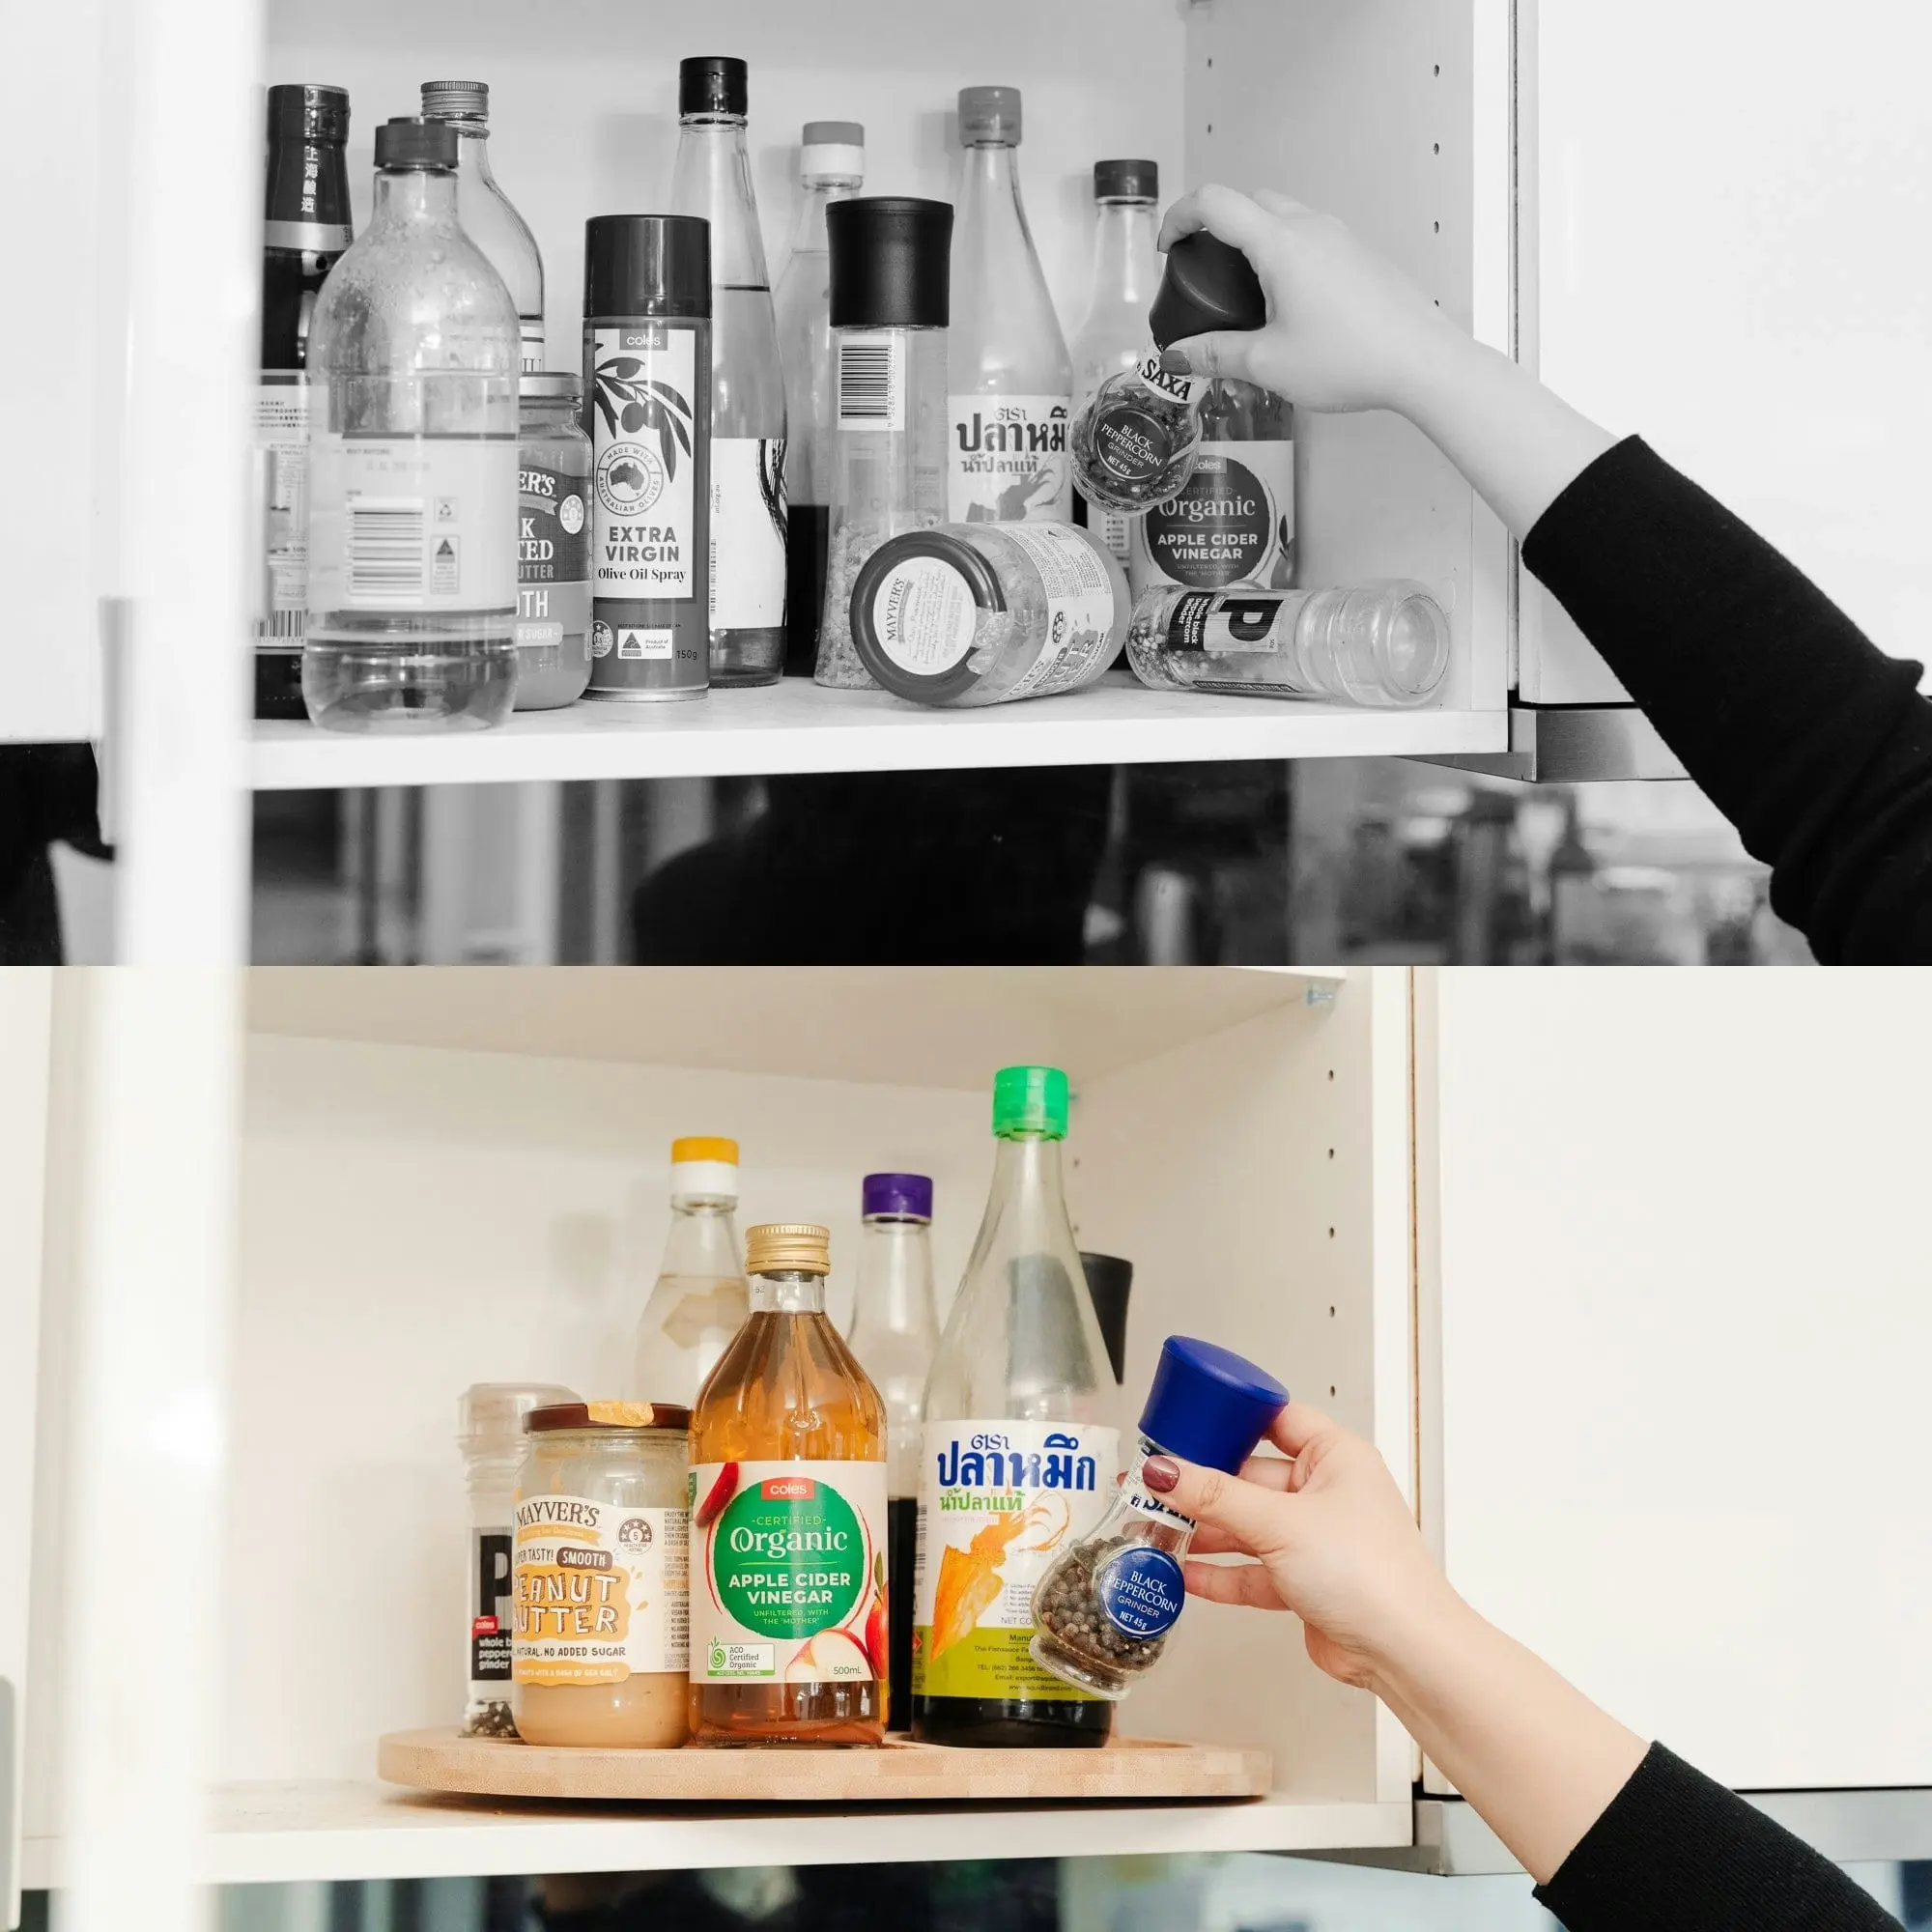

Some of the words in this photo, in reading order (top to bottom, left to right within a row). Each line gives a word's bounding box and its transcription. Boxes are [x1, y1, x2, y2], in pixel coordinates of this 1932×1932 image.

[626, 332, 661, 346] coles
[1100, 422, 1163, 466] PEPPERCORN
[1121, 424, 1154, 450] BLACK
[608, 446, 630, 460] MADE
[1107, 441, 1145, 469] GRINDER
[1106, 454, 1120, 467] NET
[1119, 462, 1132, 475] 45g
[598, 476, 635, 512] AUSTRALIAN
[1158, 495, 1256, 523] Organic
[609, 526, 677, 542] EXTRA
[1157, 533, 1207, 546] APPLE
[1210, 533, 1259, 546] CIDER
[605, 545, 680, 562] VIRGIN
[1172, 548, 1243, 560] VINEGAR
[598, 567, 626, 580] Olive
[629, 568, 648, 580] Oil
[651, 569, 687, 583] Spray
[887, 578, 905, 640] MAYVER'S
[1178, 598, 1195, 625] grinder
[1194, 598, 1209, 620] whole
[1183, 598, 1202, 643] peppercorn
[1217, 599, 1285, 642] P
[1191, 620, 1201, 644] black
[676, 649, 697, 661] 150g
[937, 1433, 1096, 1492] ปลาหมึก
[770, 1483, 808, 1495] coles
[939, 1488, 1026, 1511] น้ำปลาแท้
[516, 1501, 600, 1527] MAYVER'S
[633, 1531, 639, 1541] 5
[730, 1526, 848, 1559] Organic
[527, 1548, 554, 1562] TASTY!
[562, 1550, 607, 1568] SMOOTH
[728, 1574, 789, 1588] APPLE
[795, 1573, 851, 1587] CIDER
[1130, 1571, 1167, 1595] BLACK
[747, 1590, 833, 1605] VINEGAR
[1117, 1595, 1160, 1618] GRINDER
[753, 1609, 806, 1618] UNFILTERED,
[1119, 1610, 1134, 1623] NET
[1133, 1617, 1148, 1631] 45g
[478, 1636, 504, 1647] whole
[544, 1647, 554, 1657] NO
[557, 1647, 587, 1657] ADDED
[591, 1646, 626, 1657] SUGAR
[478, 1659, 510, 1671] grinder
[834, 1666, 862, 1675] 500mL
